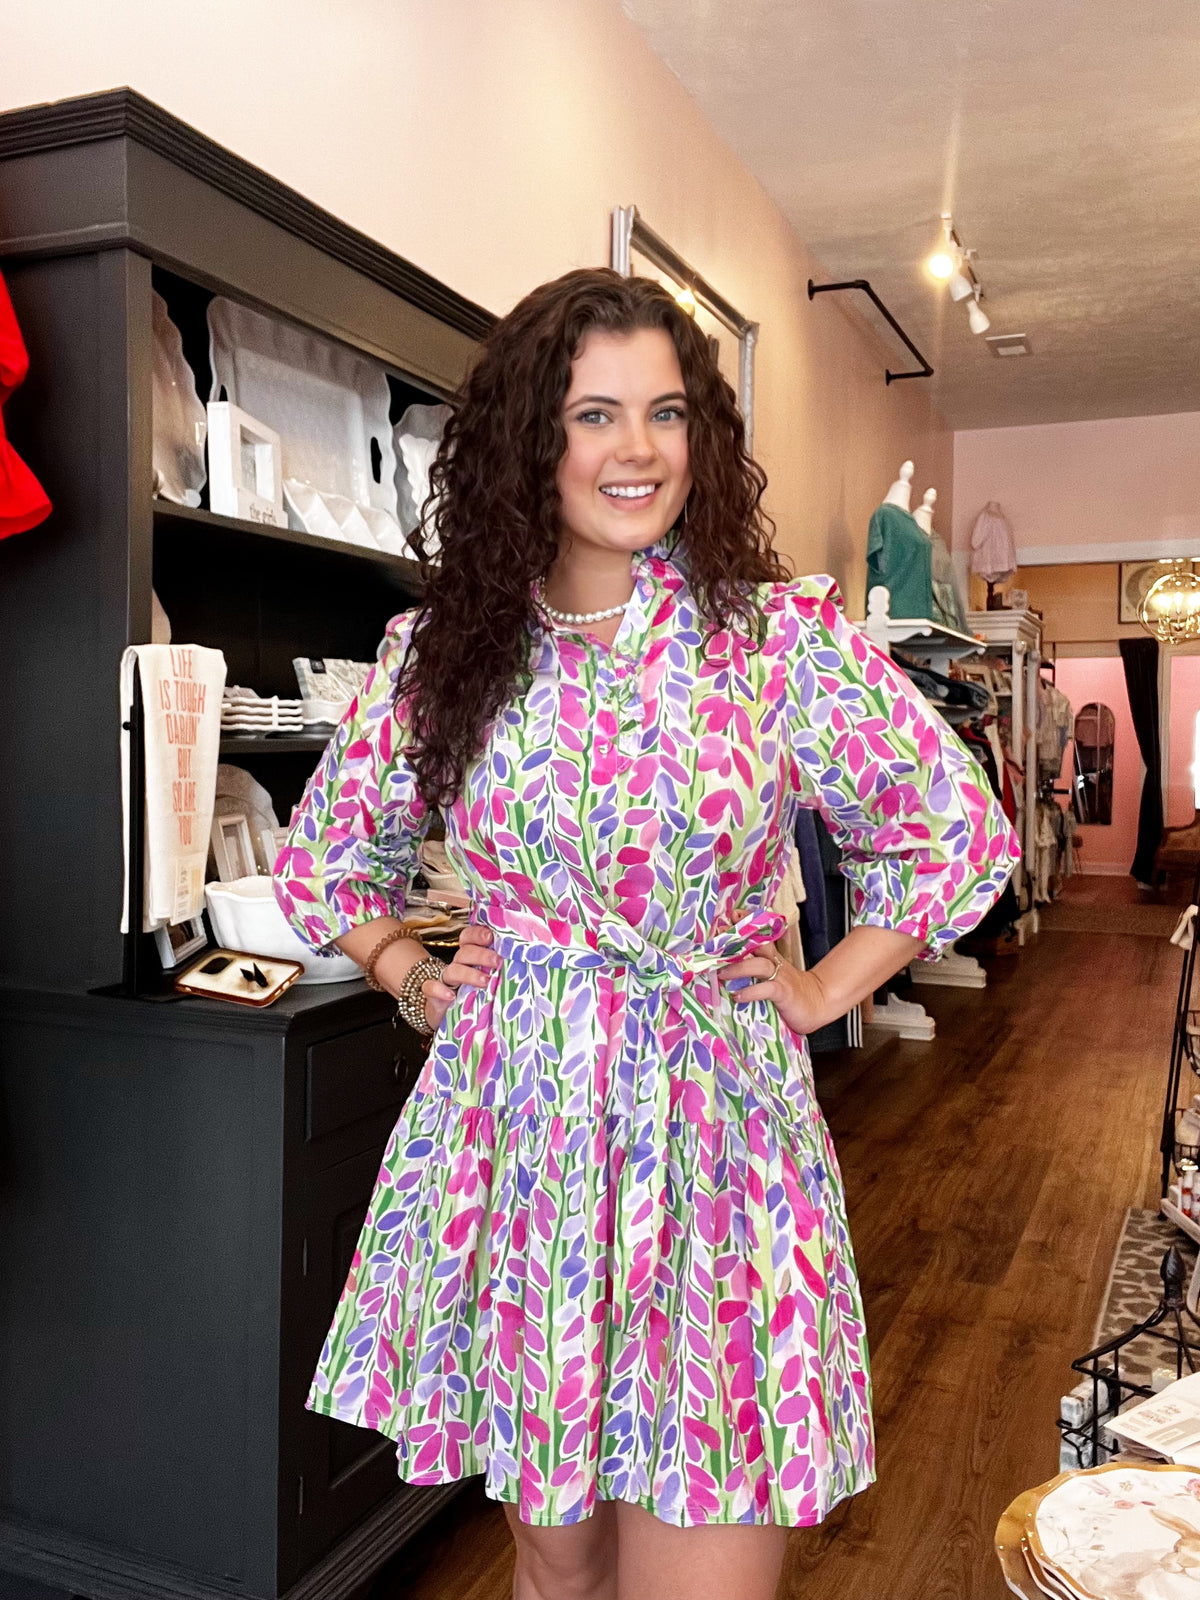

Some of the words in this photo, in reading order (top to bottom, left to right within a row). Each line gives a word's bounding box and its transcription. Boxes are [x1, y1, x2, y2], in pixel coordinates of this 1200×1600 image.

[170, 648, 193, 679] LIFE
[159, 679, 172, 711] IS
[174, 680, 207, 715] TOUGH
[177, 747, 192, 779] BUT
[172, 781, 183, 812] SO
[184, 781, 196, 812] ARE
[177, 815, 193, 846] YOU
